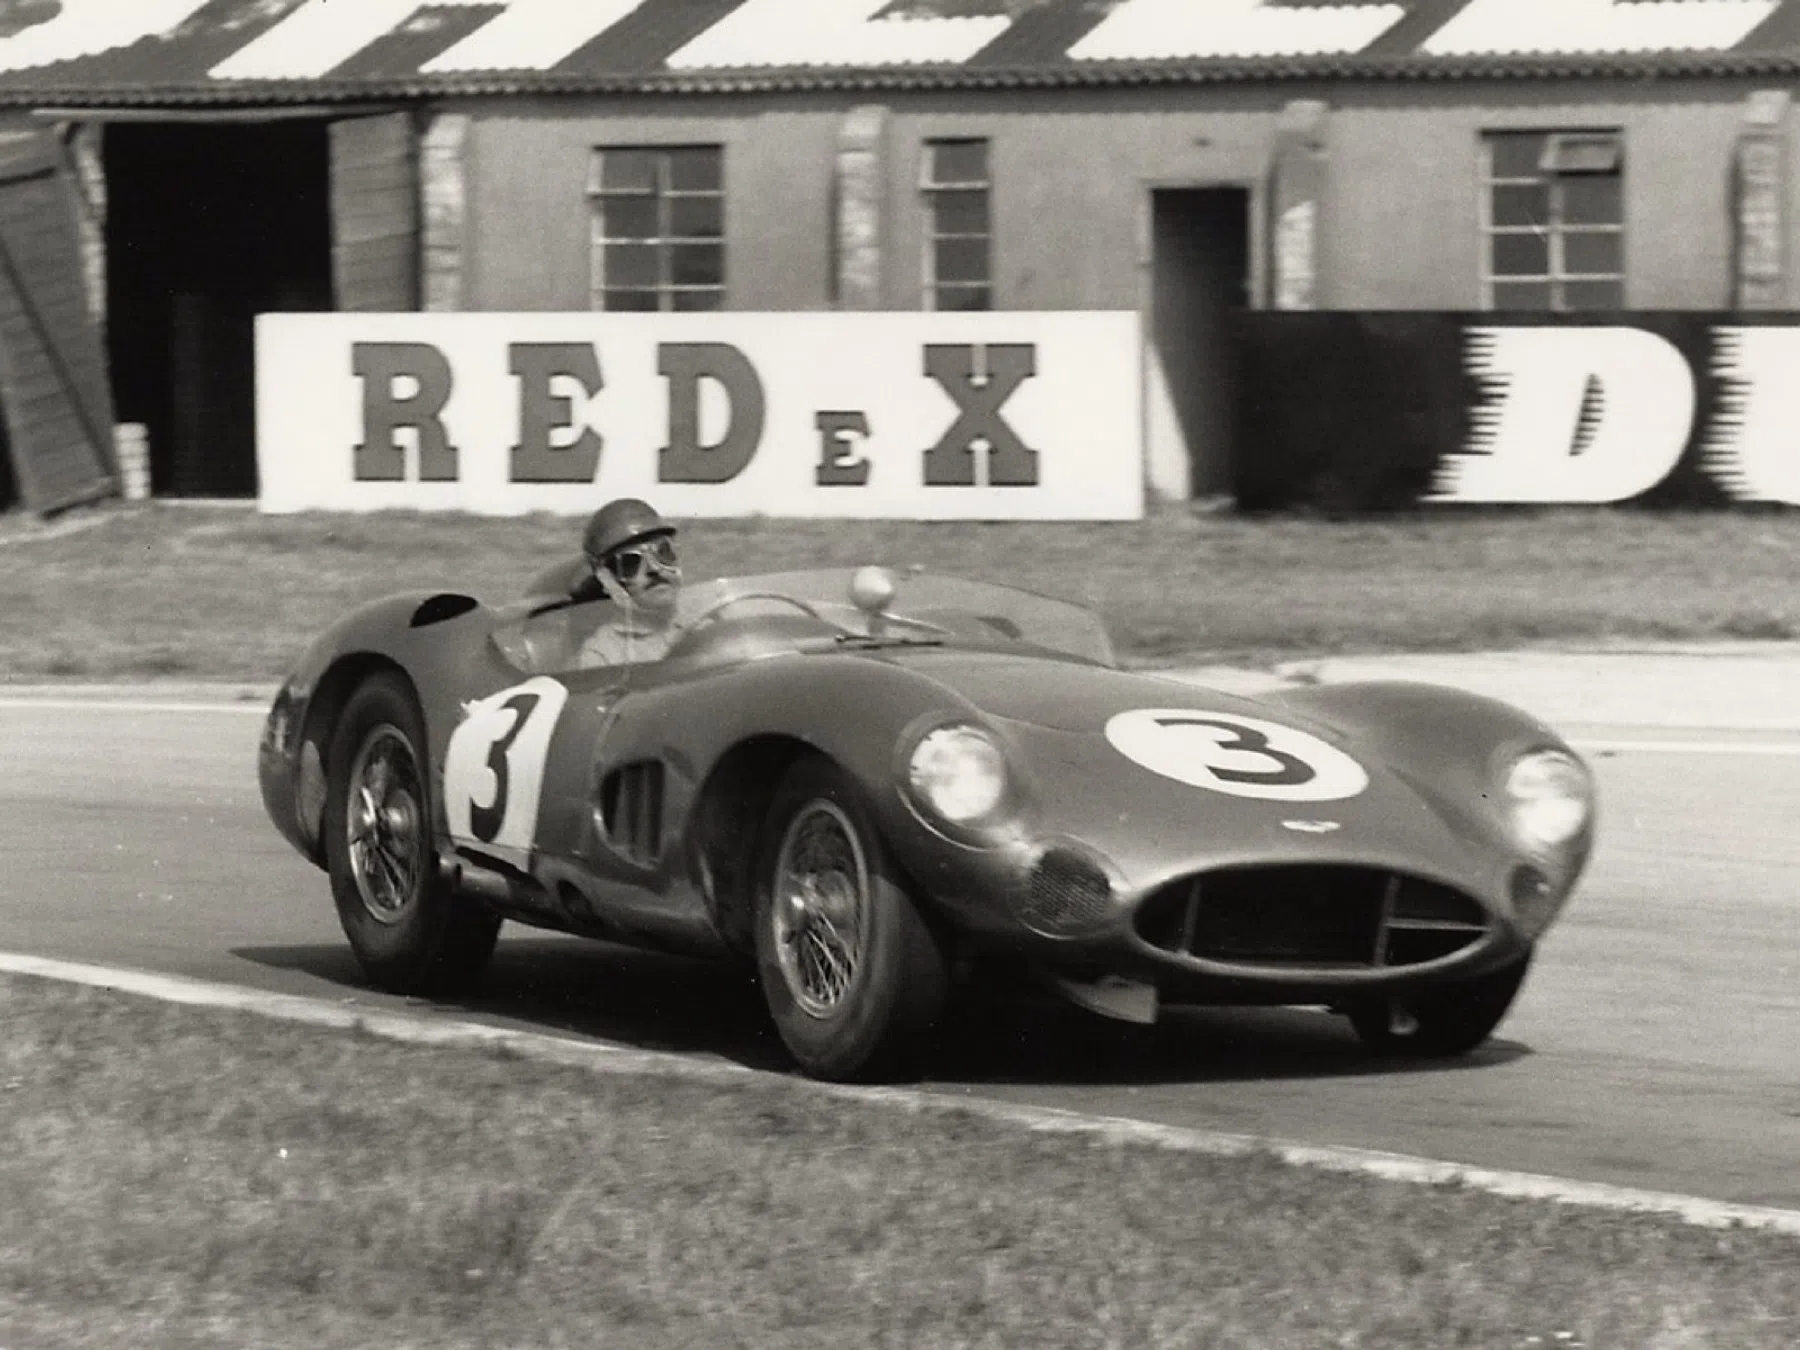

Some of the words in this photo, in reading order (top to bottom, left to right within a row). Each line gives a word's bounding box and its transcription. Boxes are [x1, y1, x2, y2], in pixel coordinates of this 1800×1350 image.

[351, 341, 1040, 487] REDEX
[469, 693, 541, 843] 3
[1153, 718, 1316, 785] 3
